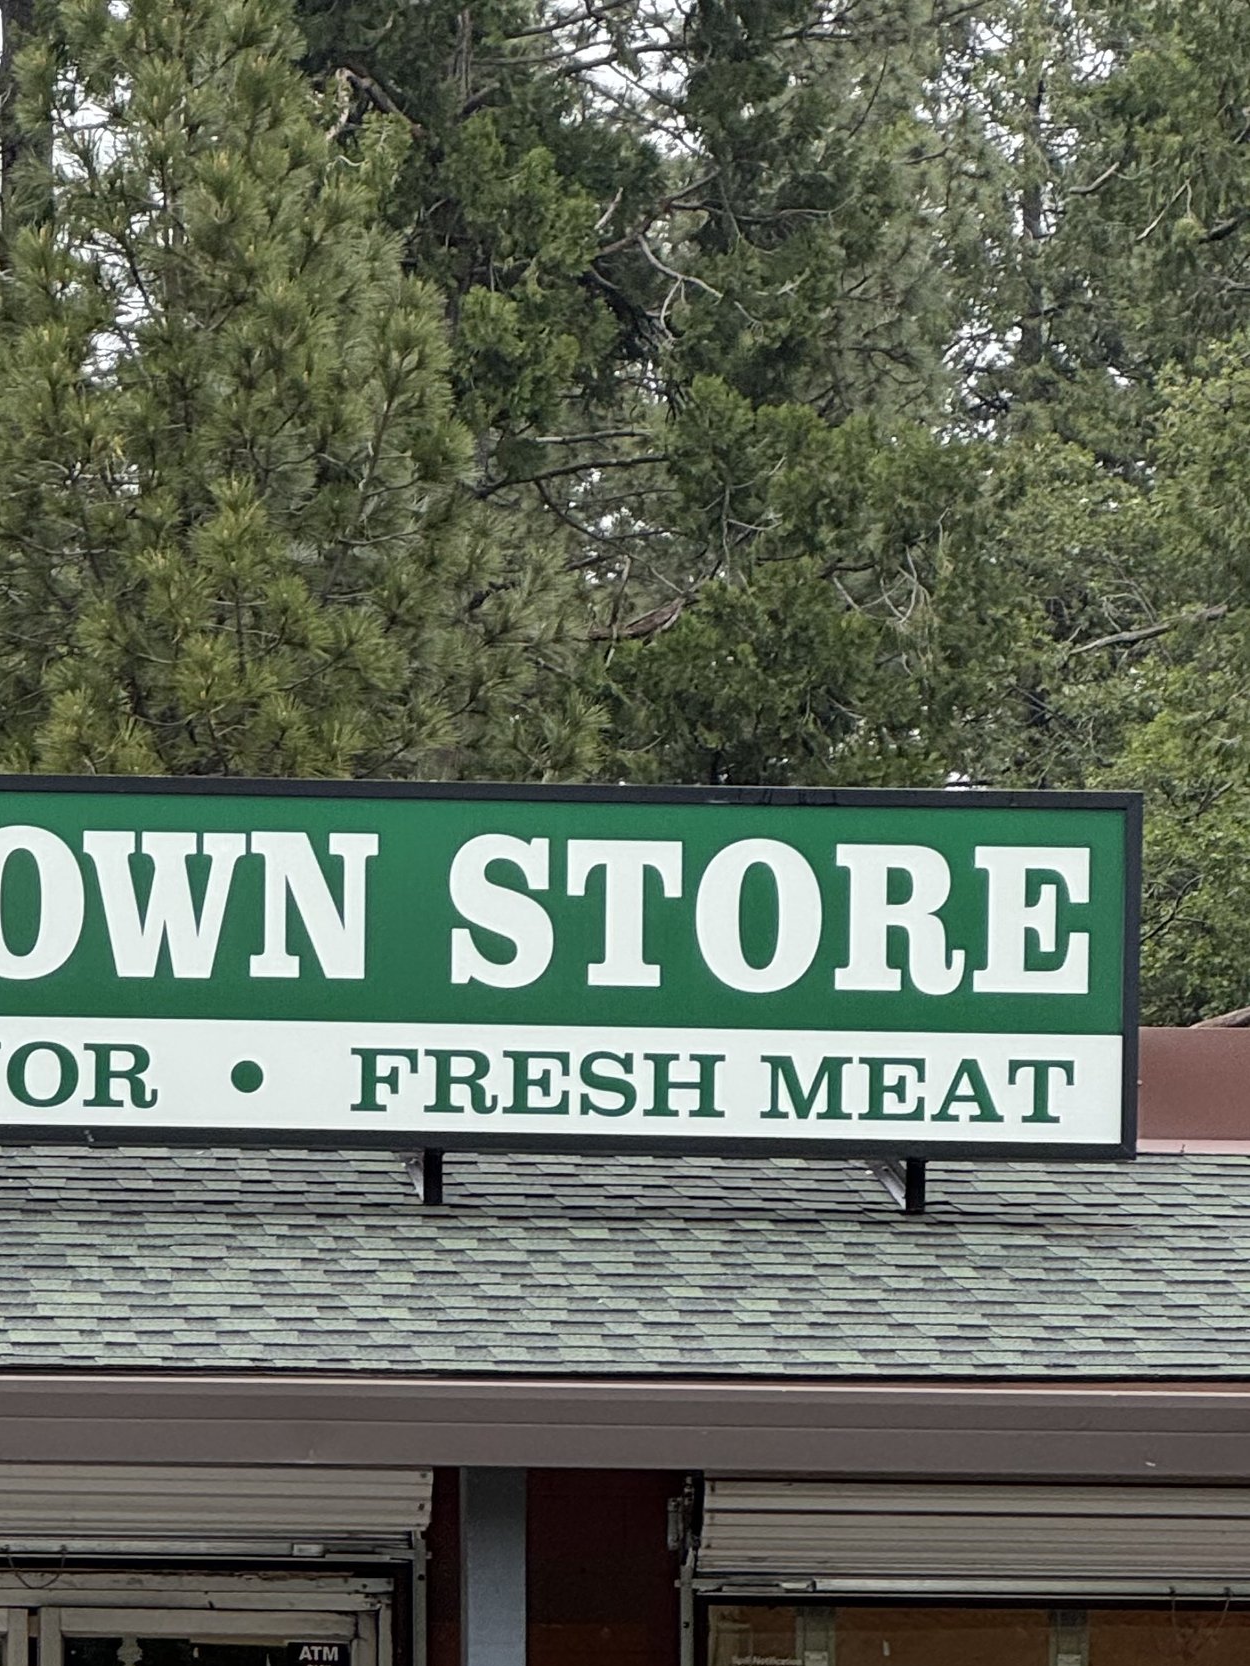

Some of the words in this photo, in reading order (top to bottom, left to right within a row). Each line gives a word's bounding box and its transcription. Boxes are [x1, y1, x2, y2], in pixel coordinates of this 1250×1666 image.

[449, 833, 1091, 995] STORE
[350, 1047, 726, 1118] FRESH
[759, 1055, 1075, 1124] MEAT
[298, 1645, 339, 1661] ATM
